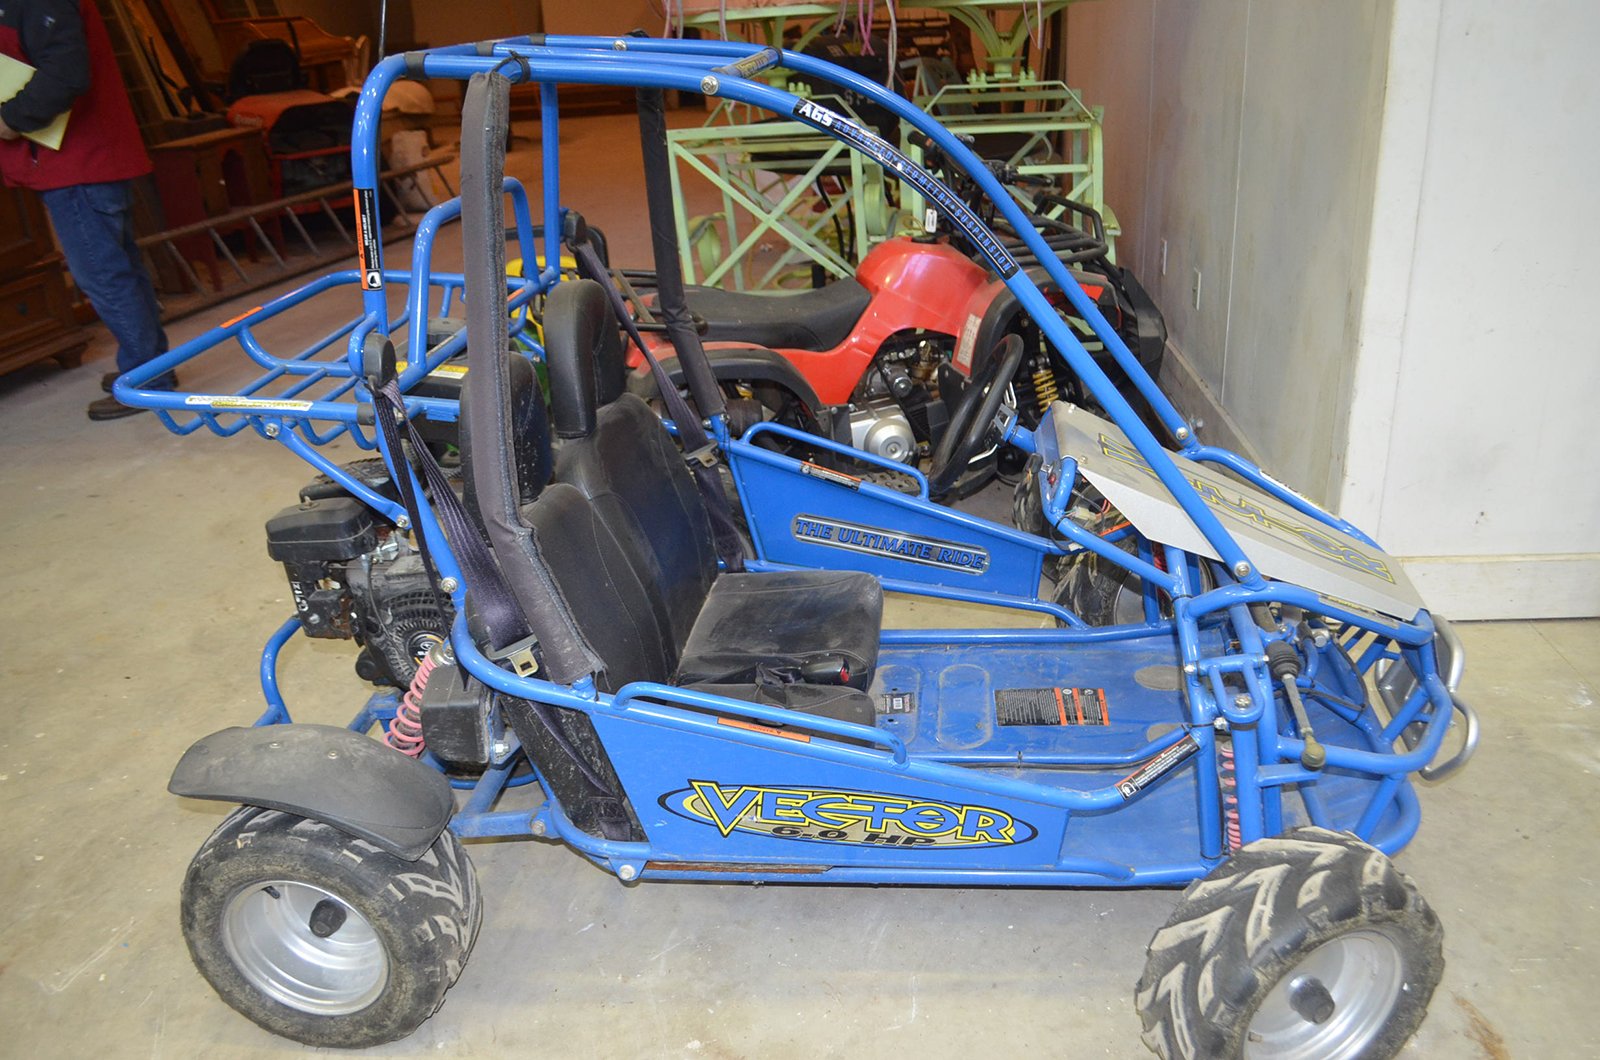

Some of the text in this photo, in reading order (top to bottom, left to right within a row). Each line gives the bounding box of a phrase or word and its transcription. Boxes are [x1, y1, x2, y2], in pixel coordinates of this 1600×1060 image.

[954, 208, 1012, 273] SUSPENSION
[796, 520, 987, 570] THE ULTIMATE RIDE
[688, 779, 1014, 843] VECTOR
[770, 826, 937, 847] 6.0 HP
